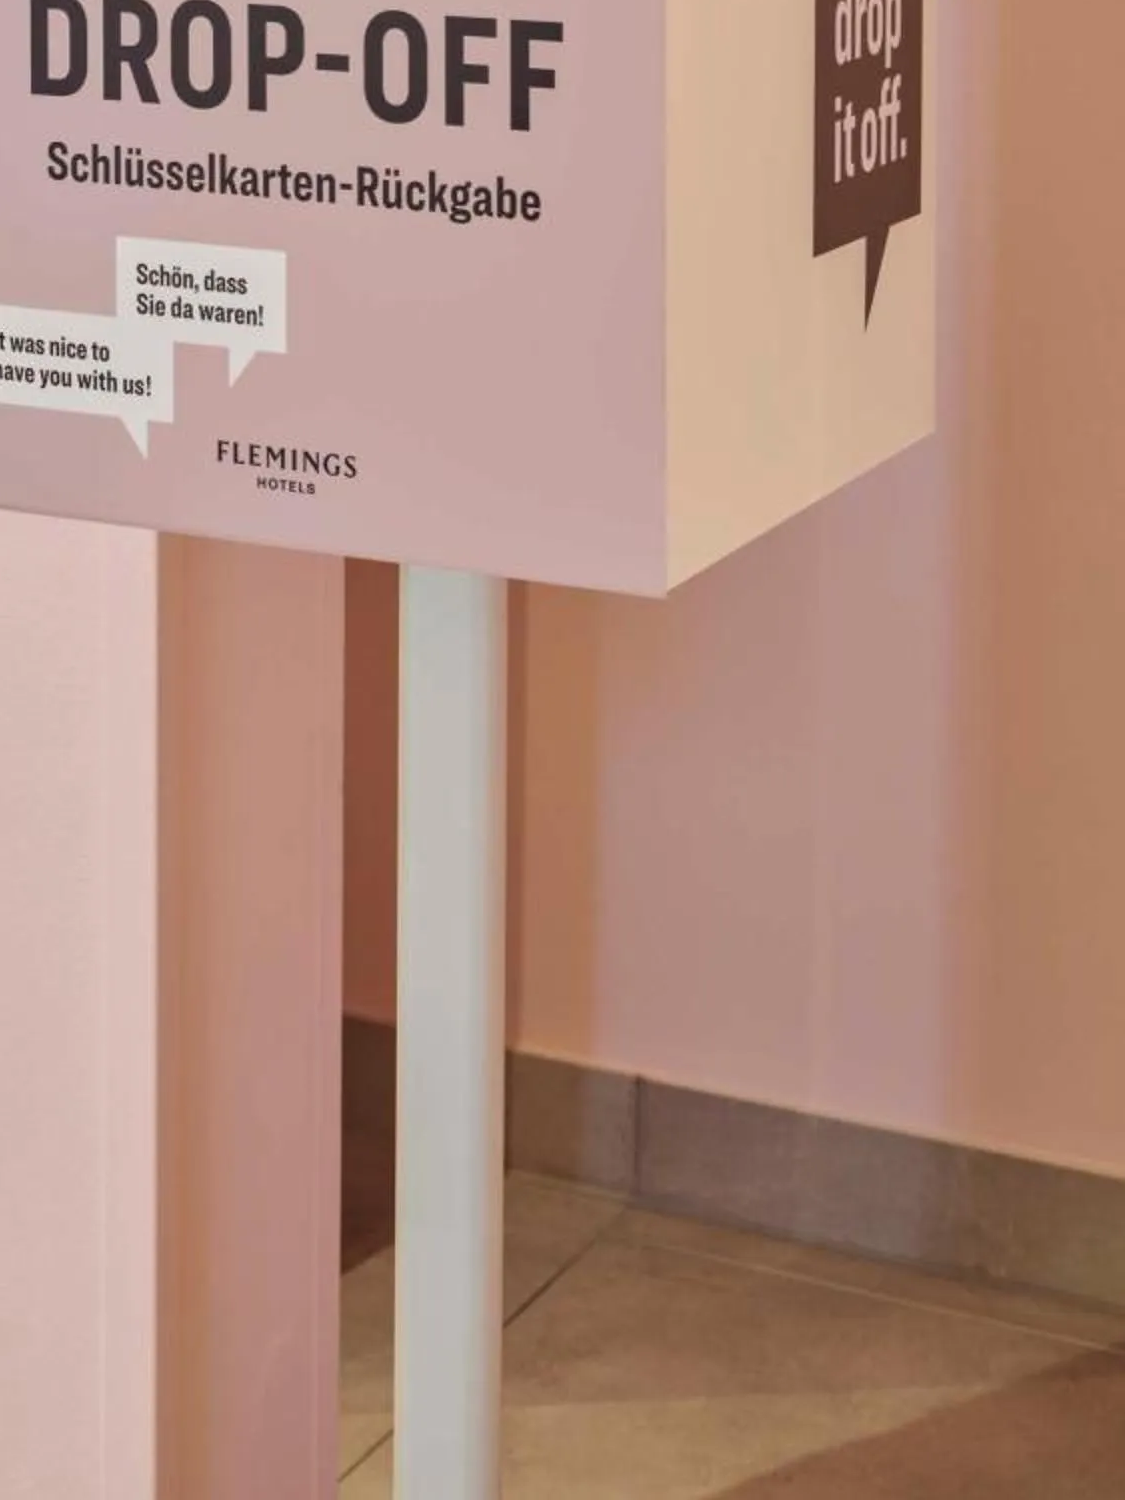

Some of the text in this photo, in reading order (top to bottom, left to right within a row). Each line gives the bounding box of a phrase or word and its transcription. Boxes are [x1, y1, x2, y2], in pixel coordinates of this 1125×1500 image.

[834, 73, 908, 184] it off.
[47, 140, 543, 226] Schlüsselkarten-Rückgabe
[135, 262, 248, 296] Schön, dass
[135, 293, 265, 328] Sie da waren!
[9, 334, 46, 357] was
[49, 336, 88, 361] nice
[91, 341, 111, 364] to
[39, 368, 74, 390] you
[76, 369, 118, 394] with
[122, 374, 153, 398] us!
[216, 438, 359, 480] FLEMINGS
[256, 476, 316, 496] HOTELS
